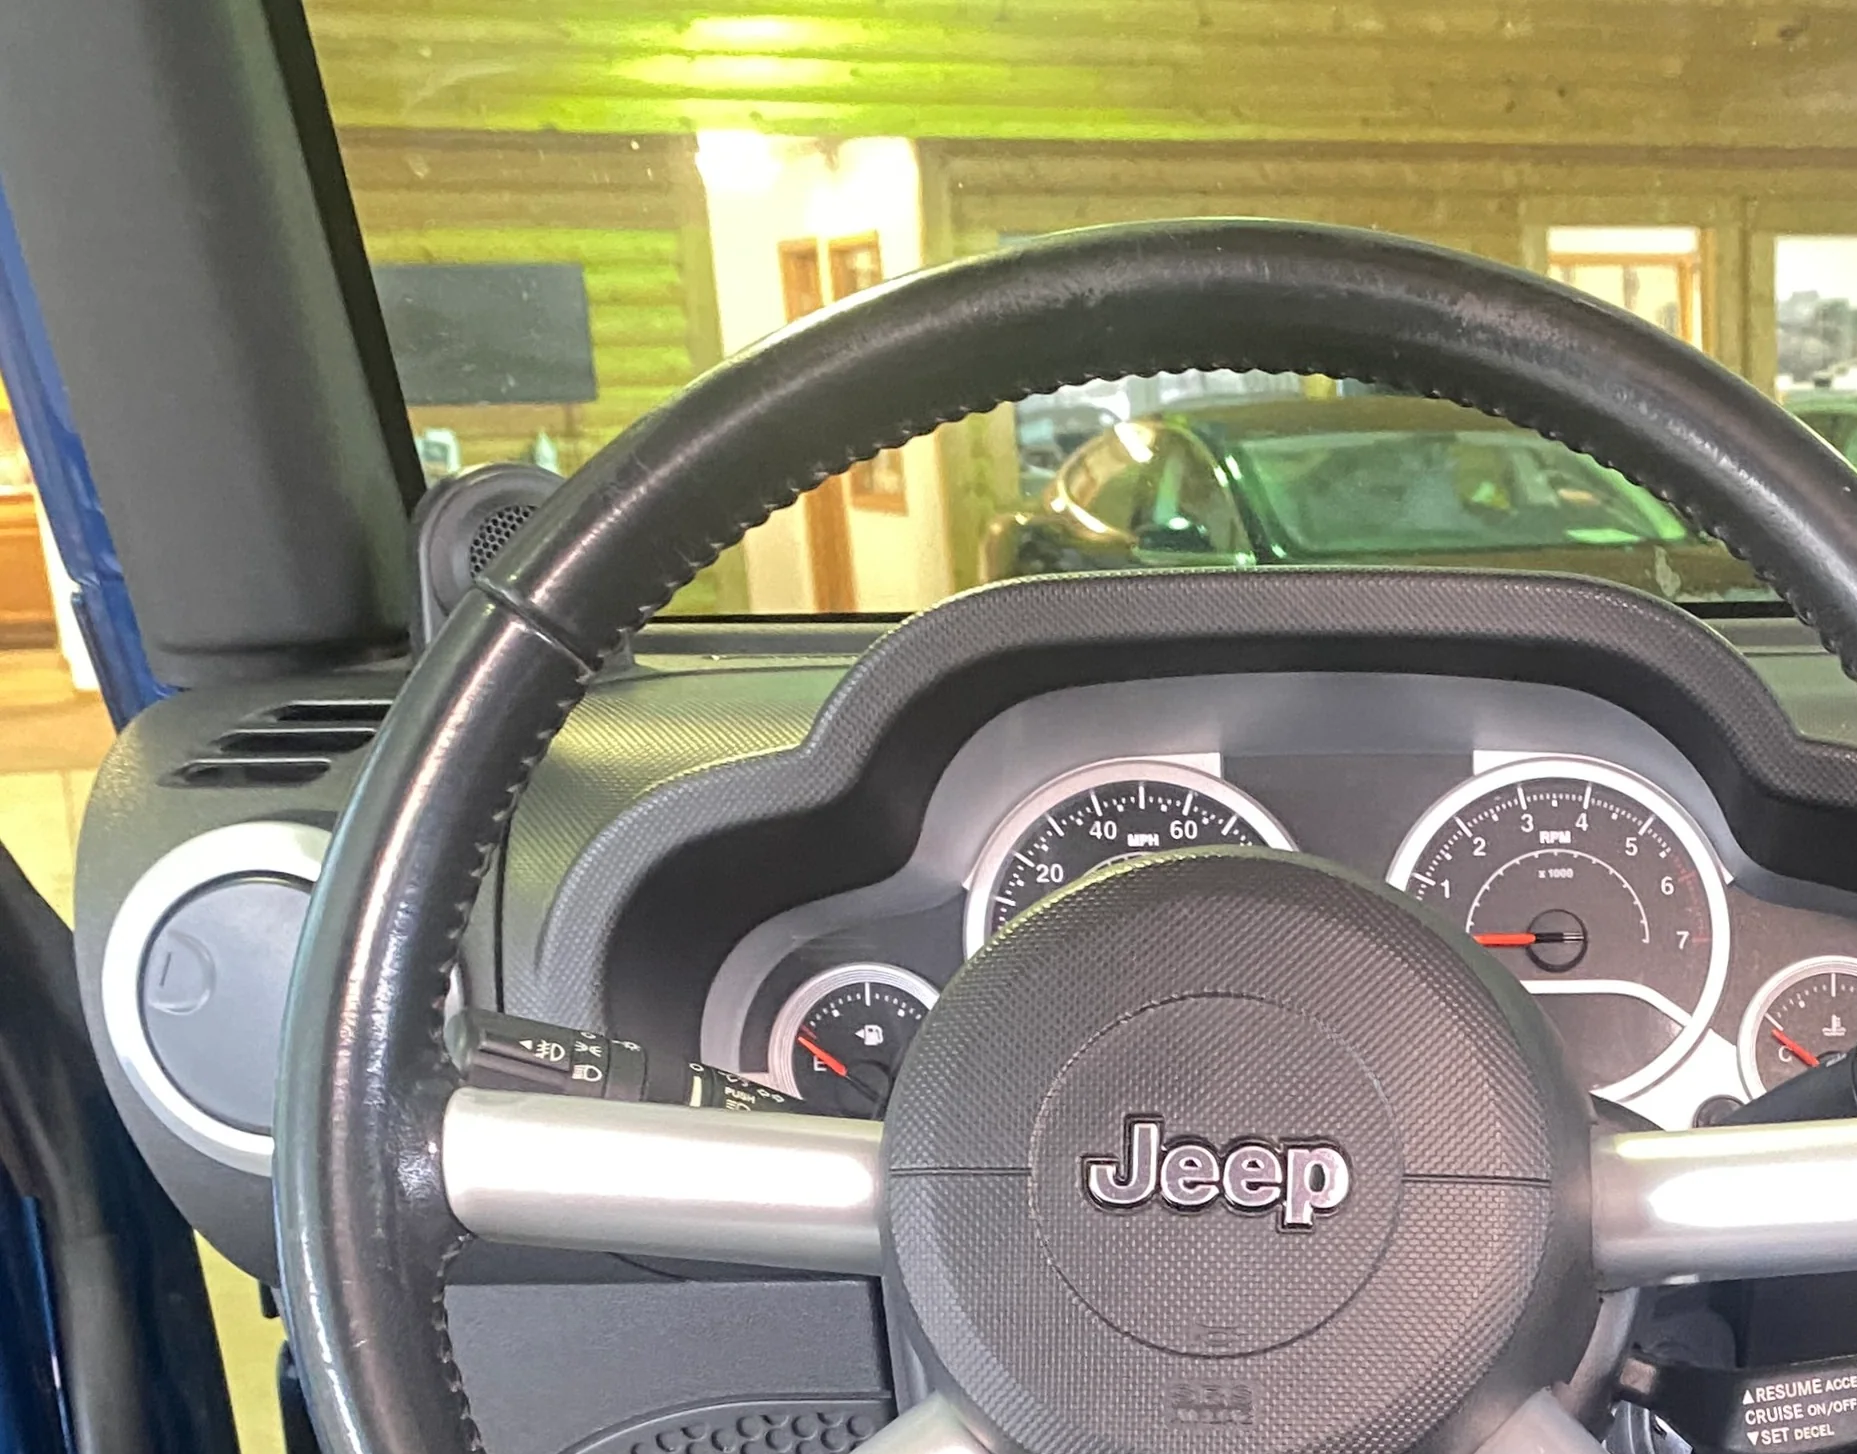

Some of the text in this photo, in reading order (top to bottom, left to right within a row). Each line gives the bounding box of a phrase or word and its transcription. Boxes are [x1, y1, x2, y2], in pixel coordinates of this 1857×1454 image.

[1089, 820, 1117, 840] 40
[1170, 820, 1198, 840] 60
[1520, 814, 1534, 833] 3
[1576, 814, 1589, 832] 4
[1127, 833, 1160, 848] MPH
[1472, 837, 1486, 857] 2
[1539, 831, 1571, 844] RPM
[1625, 837, 1638, 856] 5
[1036, 863, 1063, 883] 20
[1441, 879, 1451, 899] 1
[1661, 877, 1674, 895] 6
[1676, 930, 1690, 950] 7
[814, 1055, 827, 1072] E
[1084, 1118, 1351, 1229] Jeep
[1755, 1379, 1823, 1402] RESUME
[1744, 1397, 1857, 1425] CRUISE ON/OFF
[1761, 1423, 1835, 1446] SET DECEL
